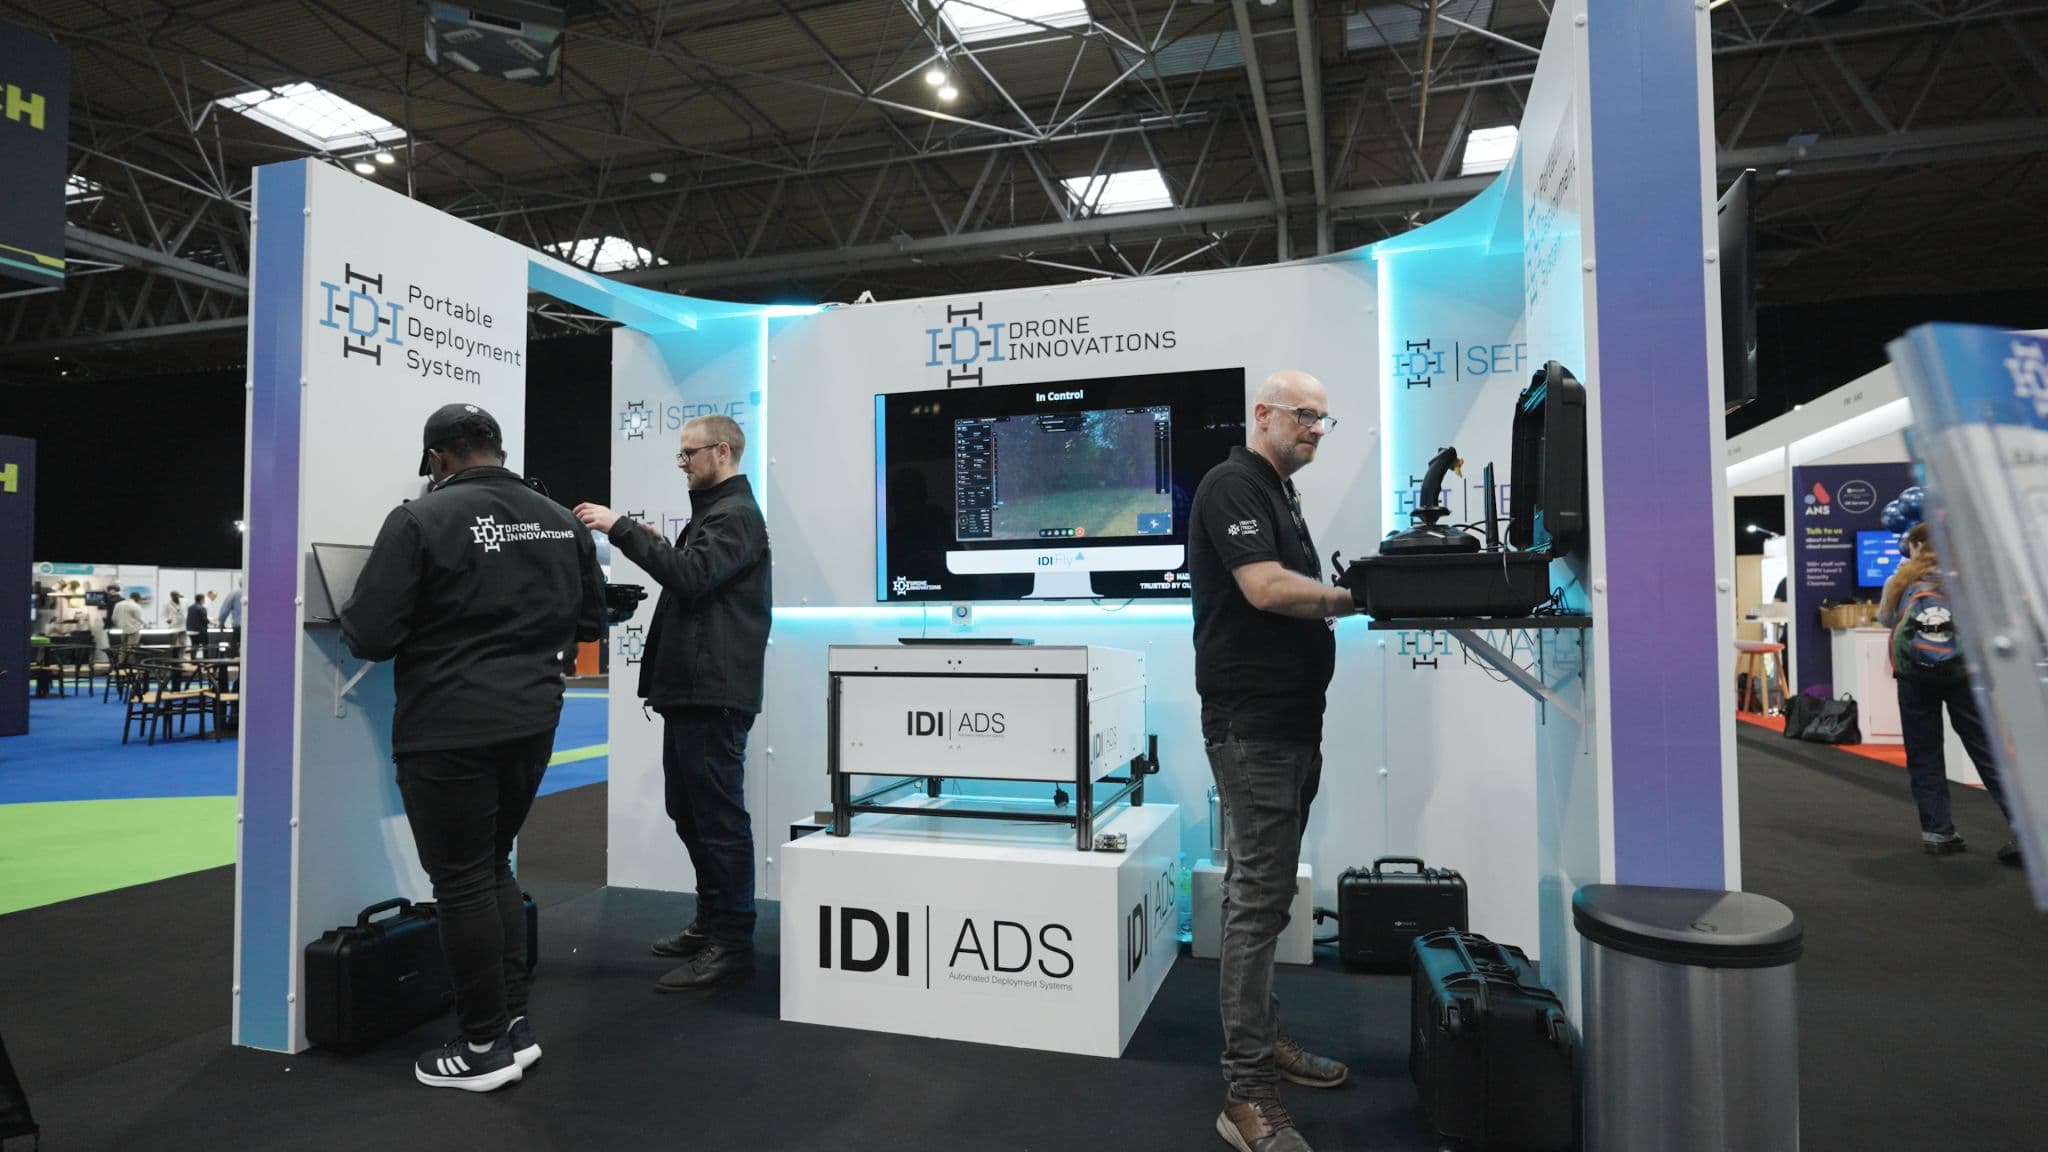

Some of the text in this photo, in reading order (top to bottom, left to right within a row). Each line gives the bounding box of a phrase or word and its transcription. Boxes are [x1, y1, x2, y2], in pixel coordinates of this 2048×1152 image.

[408, 285, 493, 328] Portable
[1009, 316, 1089, 339] DRONE
[408, 317, 521, 366] Deployment
[1008, 331, 1177, 361] INNOVATIONS
[407, 350, 481, 385] System
[1036, 389, 1084, 402] In Control
[1805, 505, 1830, 515] ANS
[505, 523, 541, 532] DRONE
[507, 530, 575, 541] INNOVATIONS
[1038, 556, 1053, 566] IDI
[907, 711, 1005, 736] IDI ADS
[1127, 894, 1147, 982] IDI
[1153, 862, 1176, 929] ADS
[819, 905, 909, 977] IDI
[949, 917, 1074, 979] ADS
[948, 972, 1073, 991] Automated Deployment Systems
